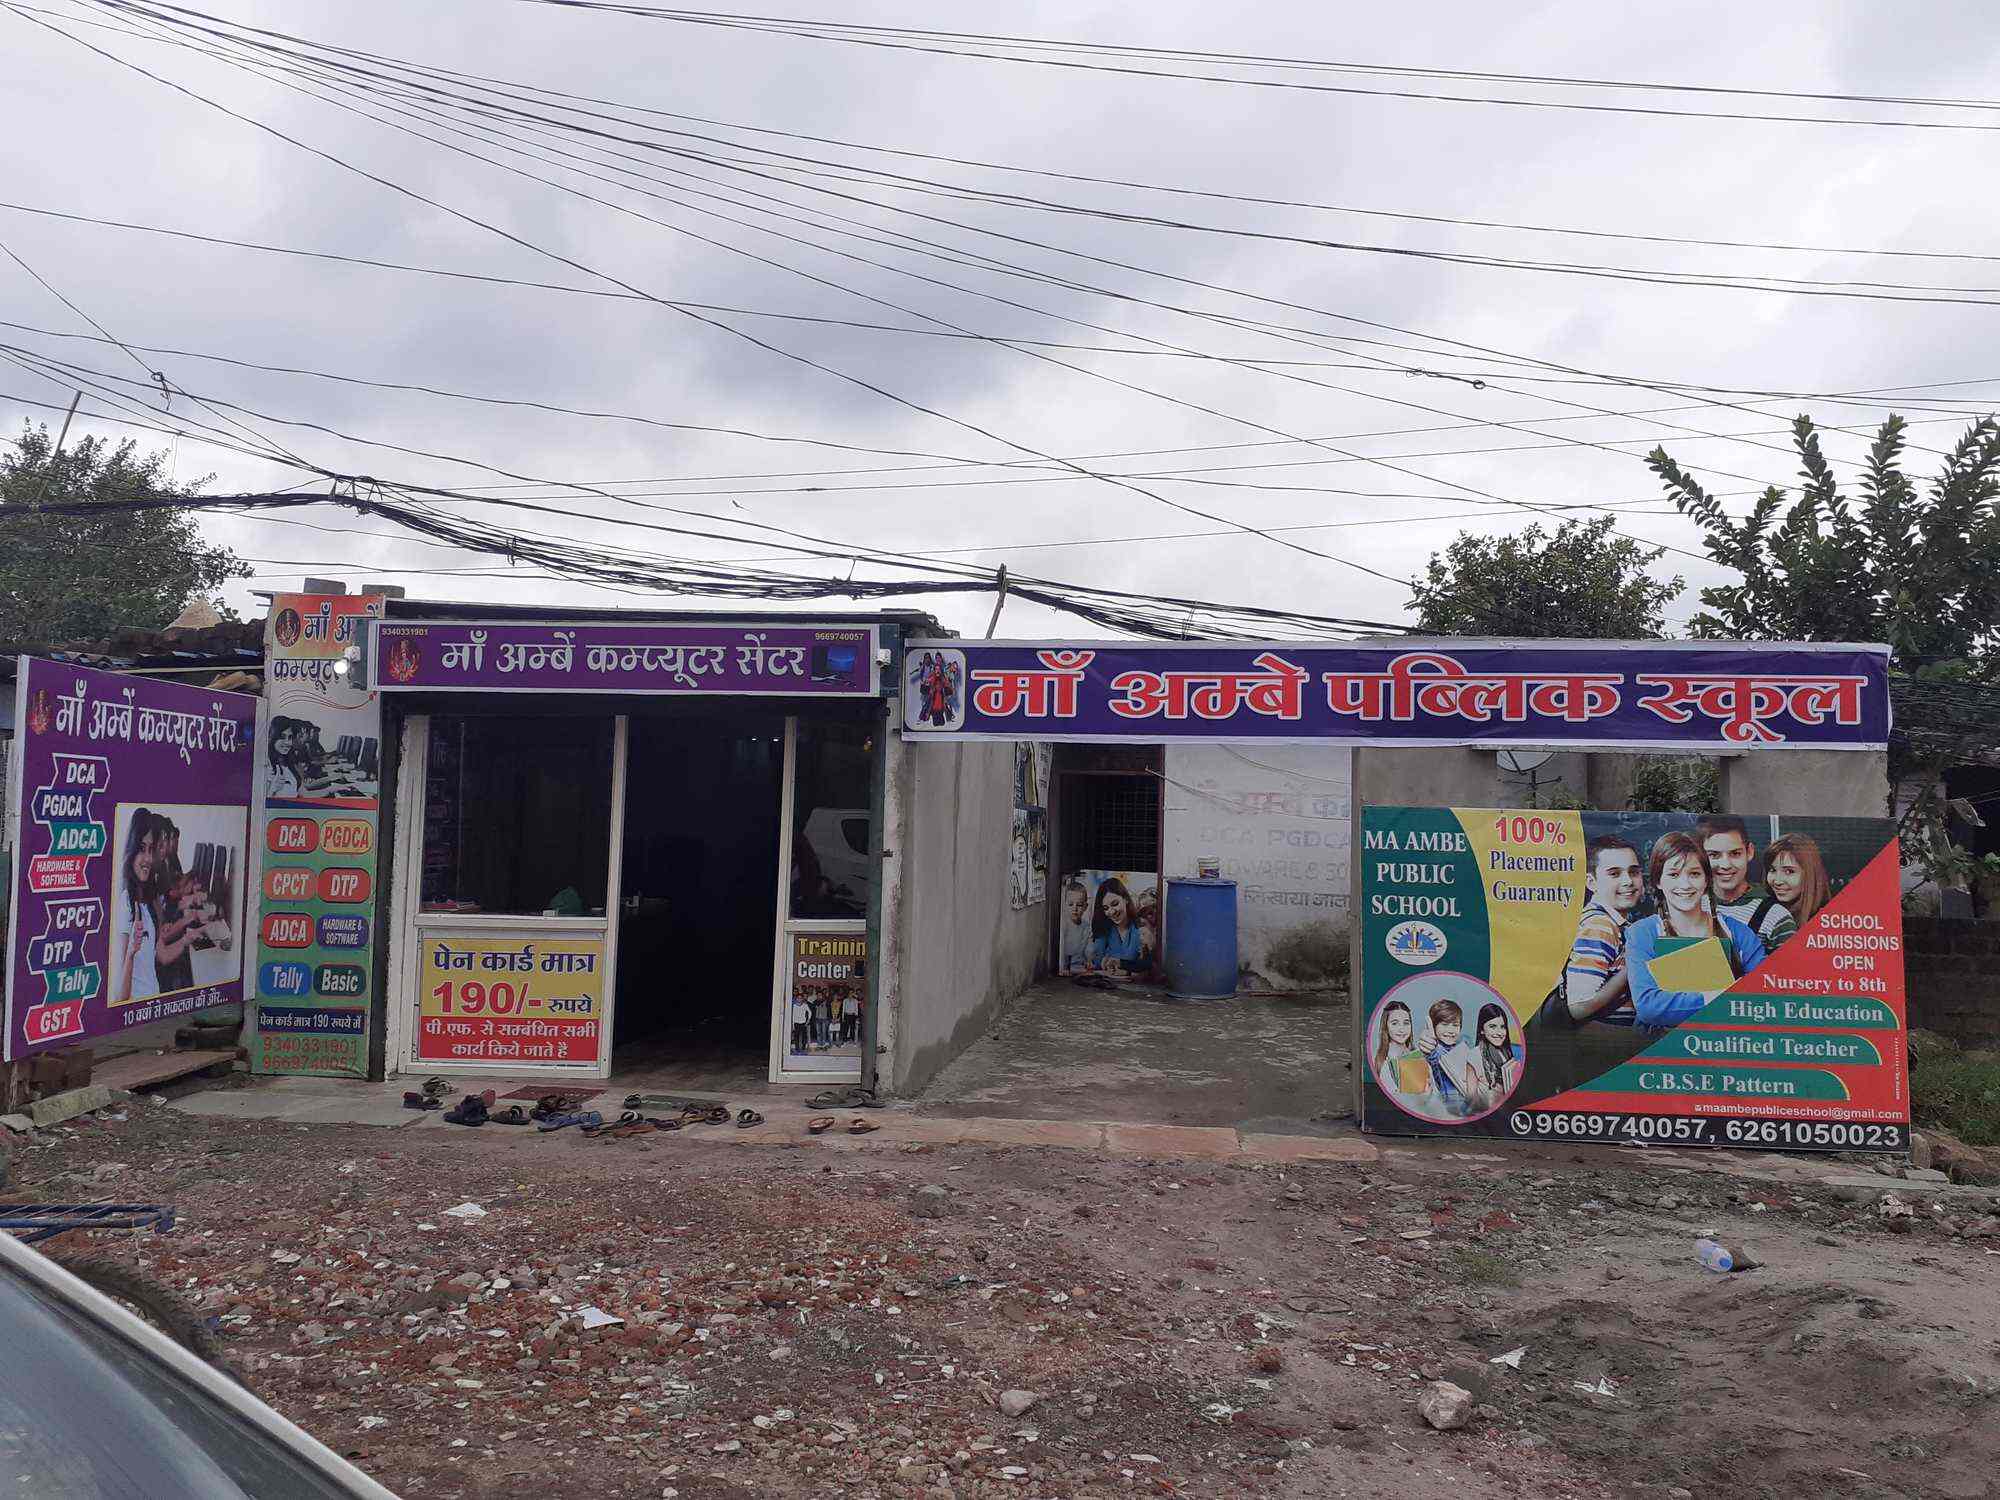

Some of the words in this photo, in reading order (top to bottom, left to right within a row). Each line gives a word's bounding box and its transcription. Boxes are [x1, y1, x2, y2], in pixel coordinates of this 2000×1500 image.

[304, 601, 330, 640] माँ
[815, 632, 864, 641] 9669740057
[441, 630, 488, 671] माँ
[585, 645, 727, 688] कम्प्यूटर
[736, 633, 806, 675] सेंटर
[971, 650, 1095, 717] माँ
[1108, 652, 1308, 720] अम्बे
[1322, 652, 1624, 722] पब्लिक
[1637, 673, 1868, 743] स्कूल
[56, 679, 87, 737] माँ
[66, 762, 96, 785] DCA
[42, 794, 82, 816] PGDCA
[57, 829, 98, 850] ADCA
[279, 825, 306, 847] DCA
[324, 826, 369, 848] PGDCA
[1365, 831, 1399, 850] MA
[1404, 831, 1467, 852] AMBE
[1495, 816, 1567, 845] 100%
[36, 860, 75, 873] HARDWARE
[1489, 851, 1575, 873] Placement
[40, 874, 77, 887] SOFTWARE
[272, 873, 310, 895] CPCT
[1376, 862, 1455, 885] PUBLIC
[330, 874, 359, 897] DTP
[1492, 881, 1573, 907] Guaranty
[56, 905, 96, 930] CPCT
[1371, 895, 1461, 918] SCHOOL
[269, 919, 306, 941] ADCA
[322, 919, 357, 930] HARDWARE
[1820, 914, 1884, 930] SCHOOL
[325, 933, 359, 945] SOFTWARE
[1806, 934, 1899, 951] ADMISSIONS
[43, 941, 73, 965] DTP
[433, 943, 475, 971] पेन
[481, 944, 534, 971] कार्ड
[541, 953, 596, 973] मात्र
[1833, 955, 1874, 971] OPEN
[272, 966, 303, 994] Tally
[322, 969, 358, 992] Basic
[798, 961, 850, 979] Center
[57, 969, 91, 995] Tally
[1762, 974, 1832, 995] Nursery
[1837, 976, 1854, 991] to
[1859, 977, 1887, 992] 8th
[433, 980, 543, 1015] 190/-
[548, 993, 593, 1014] रुपये
[40, 1007, 71, 1033] GST
[123, 1010, 134, 1026] 10
[313, 1014, 328, 1028] 190
[1730, 1000, 1776, 1022] High
[1784, 1002, 1884, 1023] Education
[480, 1020, 494, 1035] से
[562, 1021, 596, 1037] सभी
[523, 1042, 553, 1057] जाते
[1684, 1035, 1774, 1055] Qualified
[1780, 1038, 1858, 1057] Teacher
[1639, 1072, 1715, 1091] C.B.S.E
[1722, 1075, 1795, 1094] Pattern
[1536, 1114, 1716, 1143] 9669740057,
[1726, 1120, 1900, 1147] 6261050023
